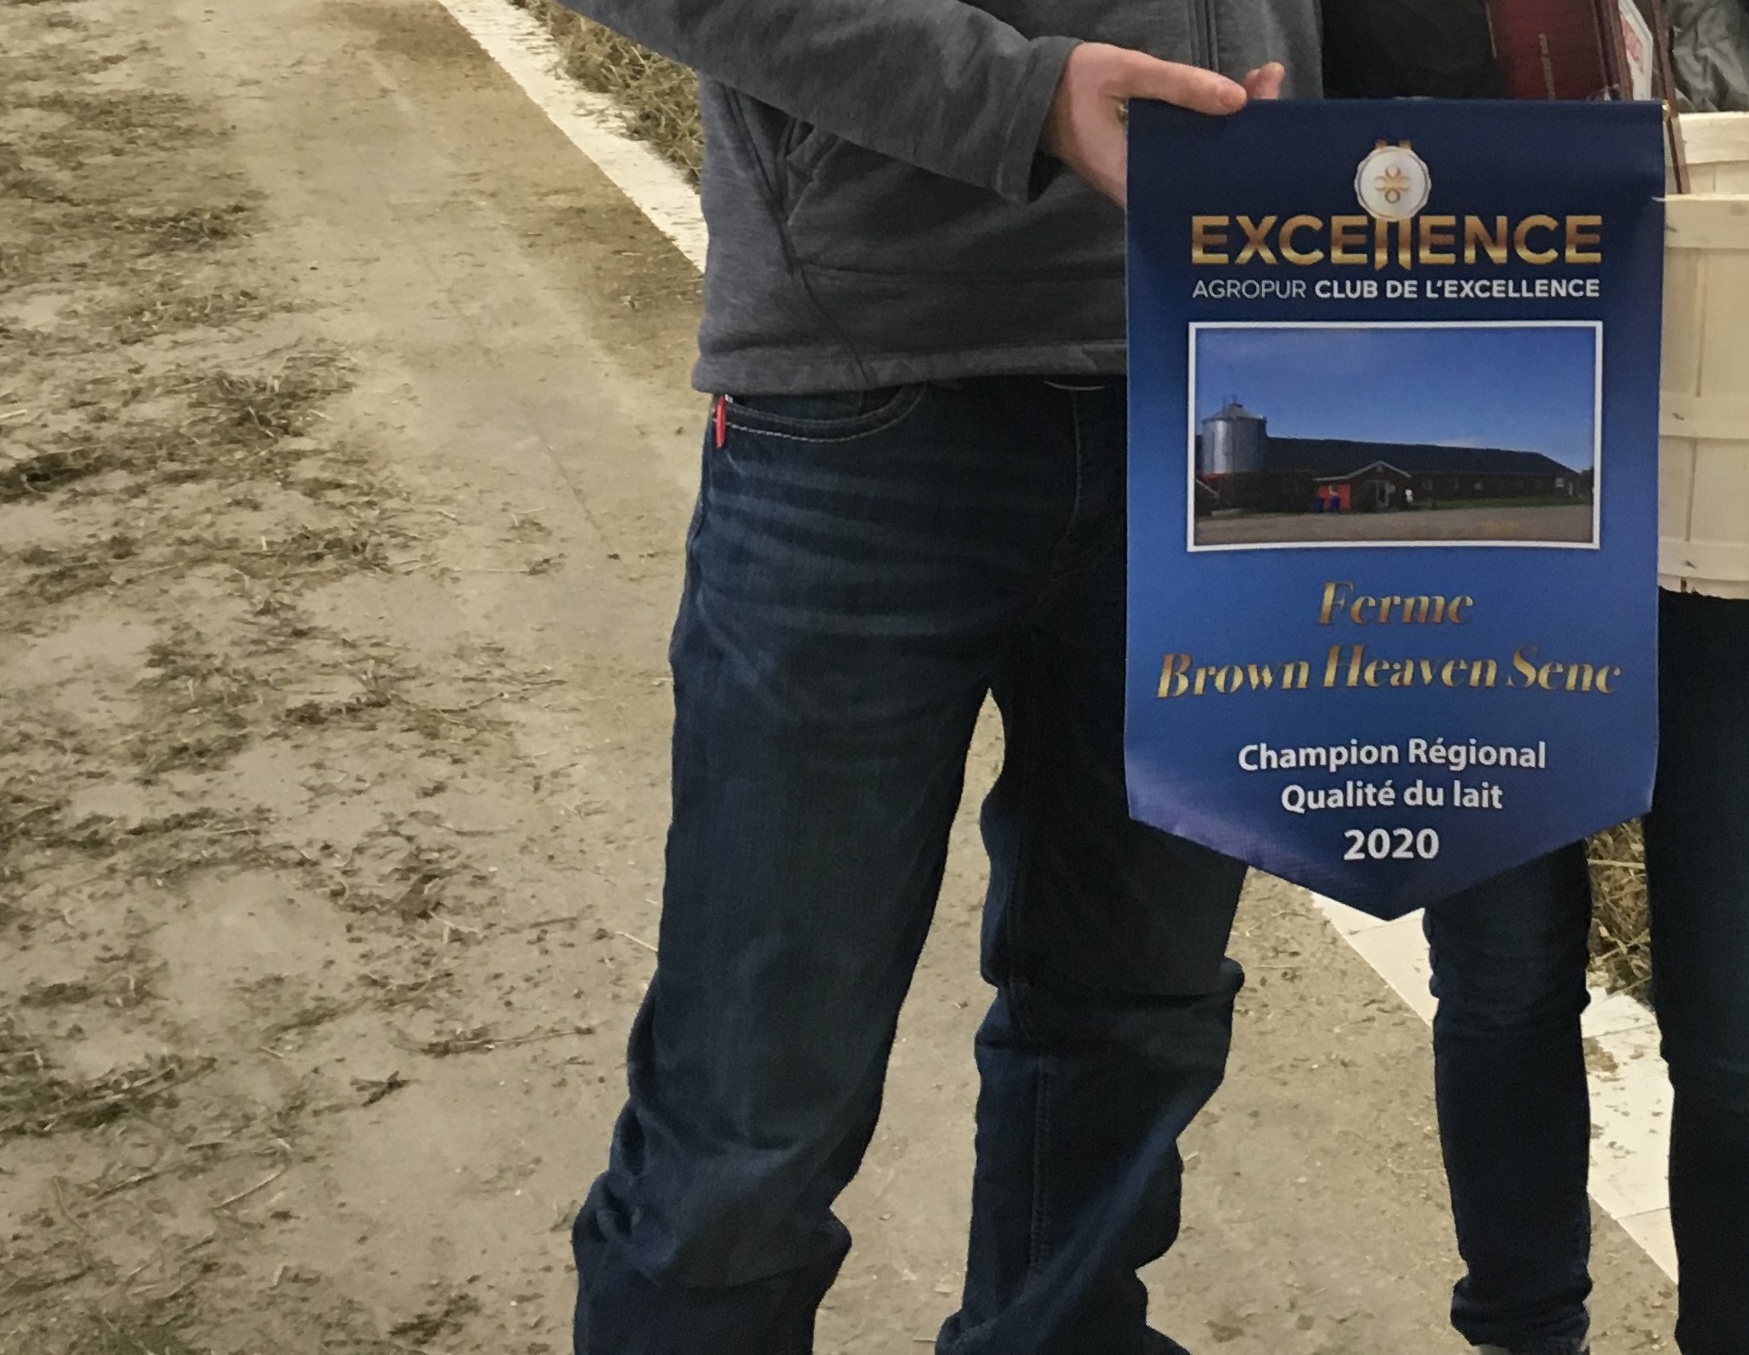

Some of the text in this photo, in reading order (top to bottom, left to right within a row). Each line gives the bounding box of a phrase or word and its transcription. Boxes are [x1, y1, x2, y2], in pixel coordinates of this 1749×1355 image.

[1192, 278, 1601, 300] AGROPUR CLUB DE L'EXCELLENCE
[1318, 580, 1475, 625] Ferme
[1157, 644, 1622, 698] Brown Heaven Senc
[1238, 737, 1547, 772] Champion Régional
[1281, 779, 1504, 813] Qualité du lait
[1343, 828, 1440, 861] 2020
